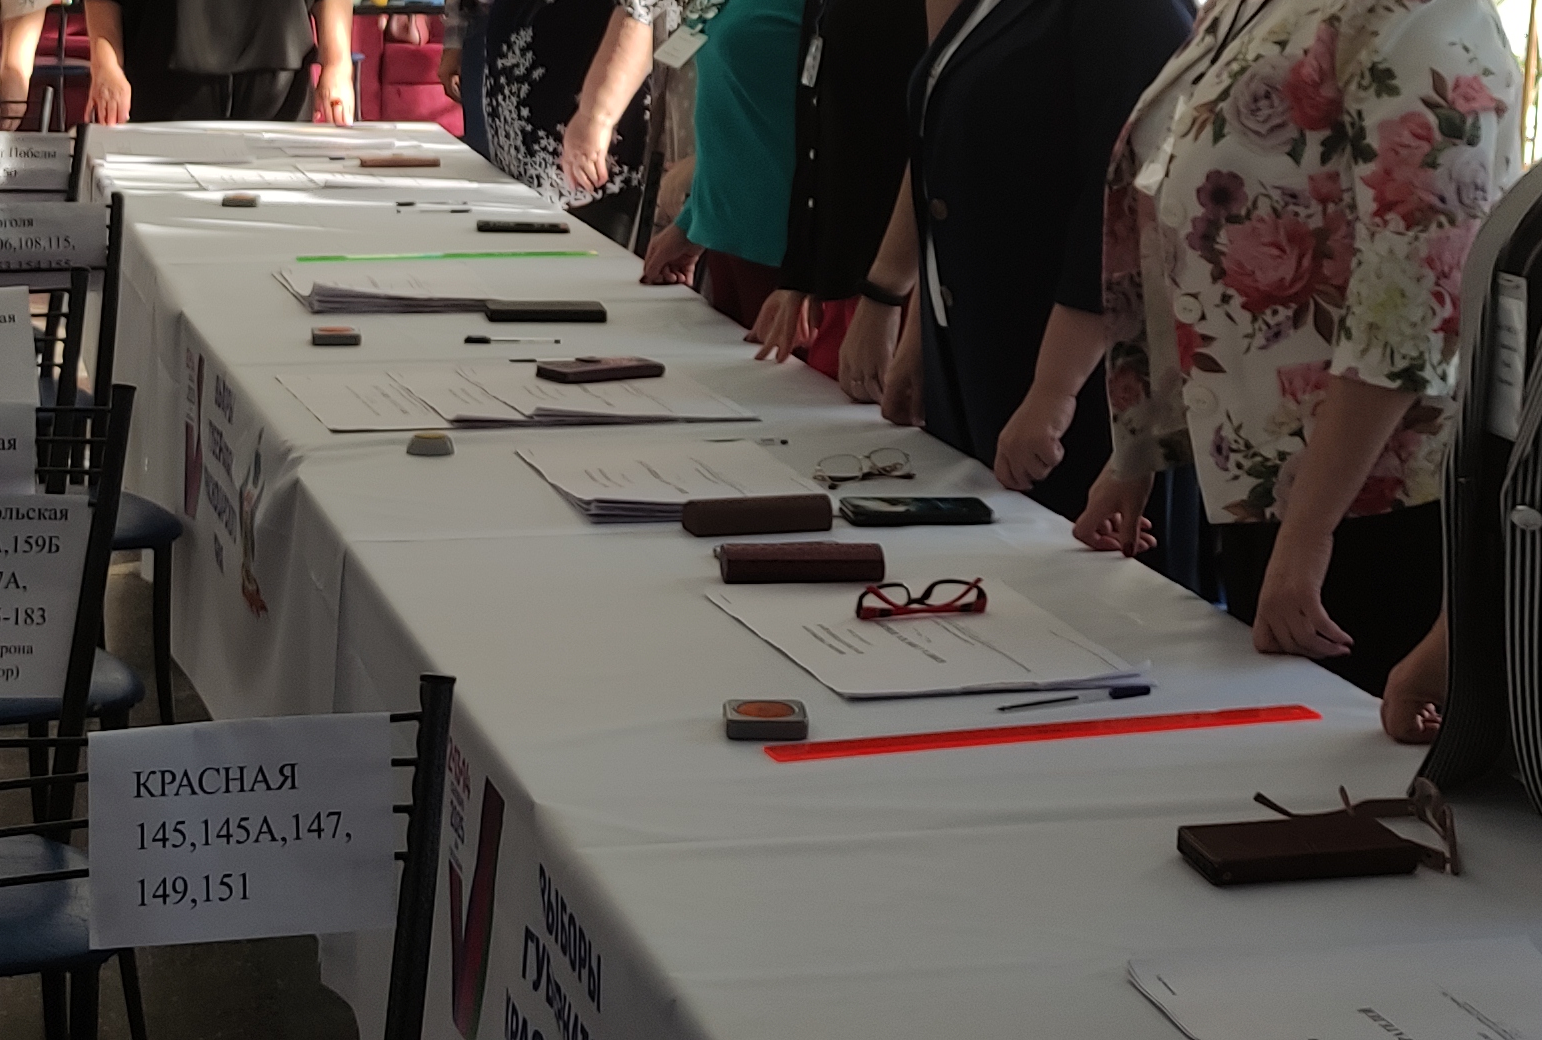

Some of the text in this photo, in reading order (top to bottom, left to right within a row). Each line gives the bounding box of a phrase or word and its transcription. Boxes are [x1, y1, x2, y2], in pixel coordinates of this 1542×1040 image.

[8, 145, 57, 159] Победы
[132, 762, 299, 799] КРАСНАЯ
[136, 810, 352, 853] 145,145А,147,
[136, 872, 251, 910] 149,151
